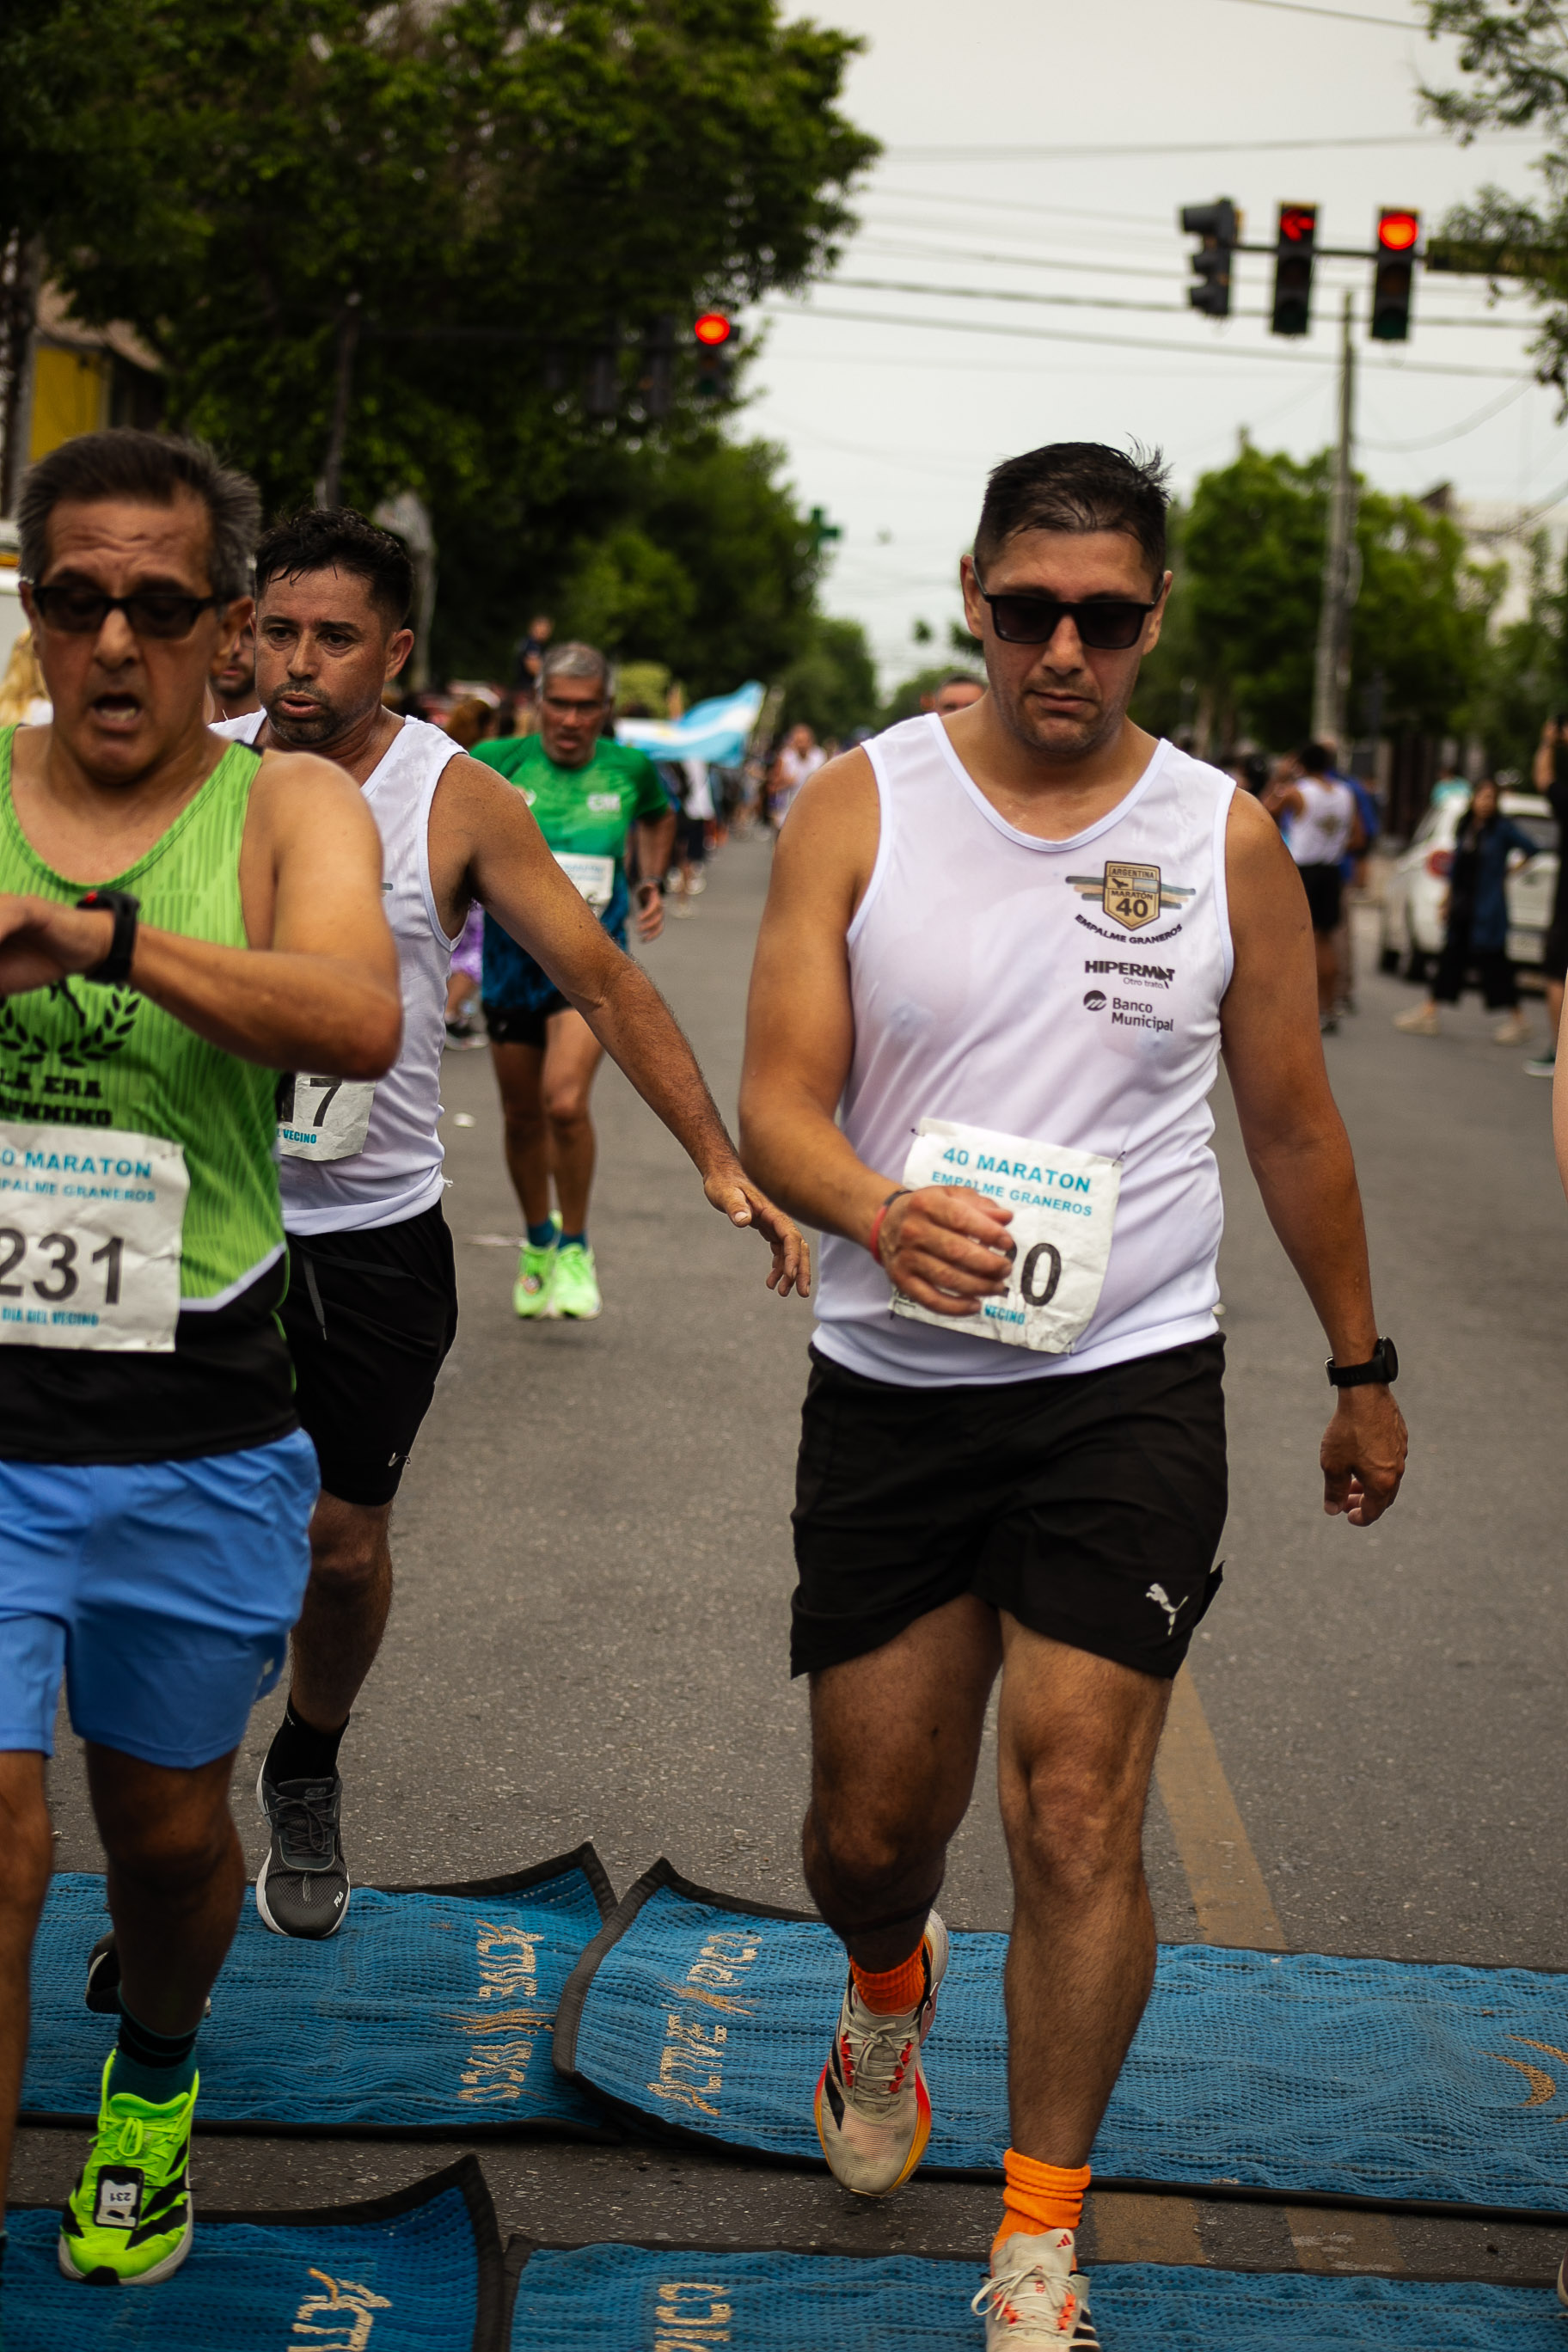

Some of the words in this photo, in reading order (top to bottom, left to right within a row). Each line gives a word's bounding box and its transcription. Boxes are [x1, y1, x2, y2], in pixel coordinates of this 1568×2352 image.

[1112, 867, 1155, 879] ARGENTINA
[1111, 890, 1153, 901] MARATÓN
[1116, 898, 1148, 918] 40
[1075, 914, 1126, 943] EMPALME
[1129, 923, 1183, 945] GRANEROS
[1123, 977, 1142, 986] Otro
[1112, 998, 1153, 1013] Banco
[1112, 1012, 1174, 1032] Municipal
[283, 1129, 317, 1144] VECINO
[25, 1151, 152, 1179] MARATON
[943, 1147, 969, 1166] 40
[977, 1155, 1091, 1193] MARATON
[0, 1179, 57, 1195] PALME
[63, 1185, 156, 1204] GRANEROS
[1009, 1189, 1093, 1216] GRANEROS
[0, 1228, 125, 1305] 231
[1004, 1240, 1062, 1307] 0
[52, 1311, 99, 1326] VECINO
[984, 1304, 1026, 1326] VECINO
[334, 1890, 344, 1908] FILA
[110, 2192, 132, 2202] 231
